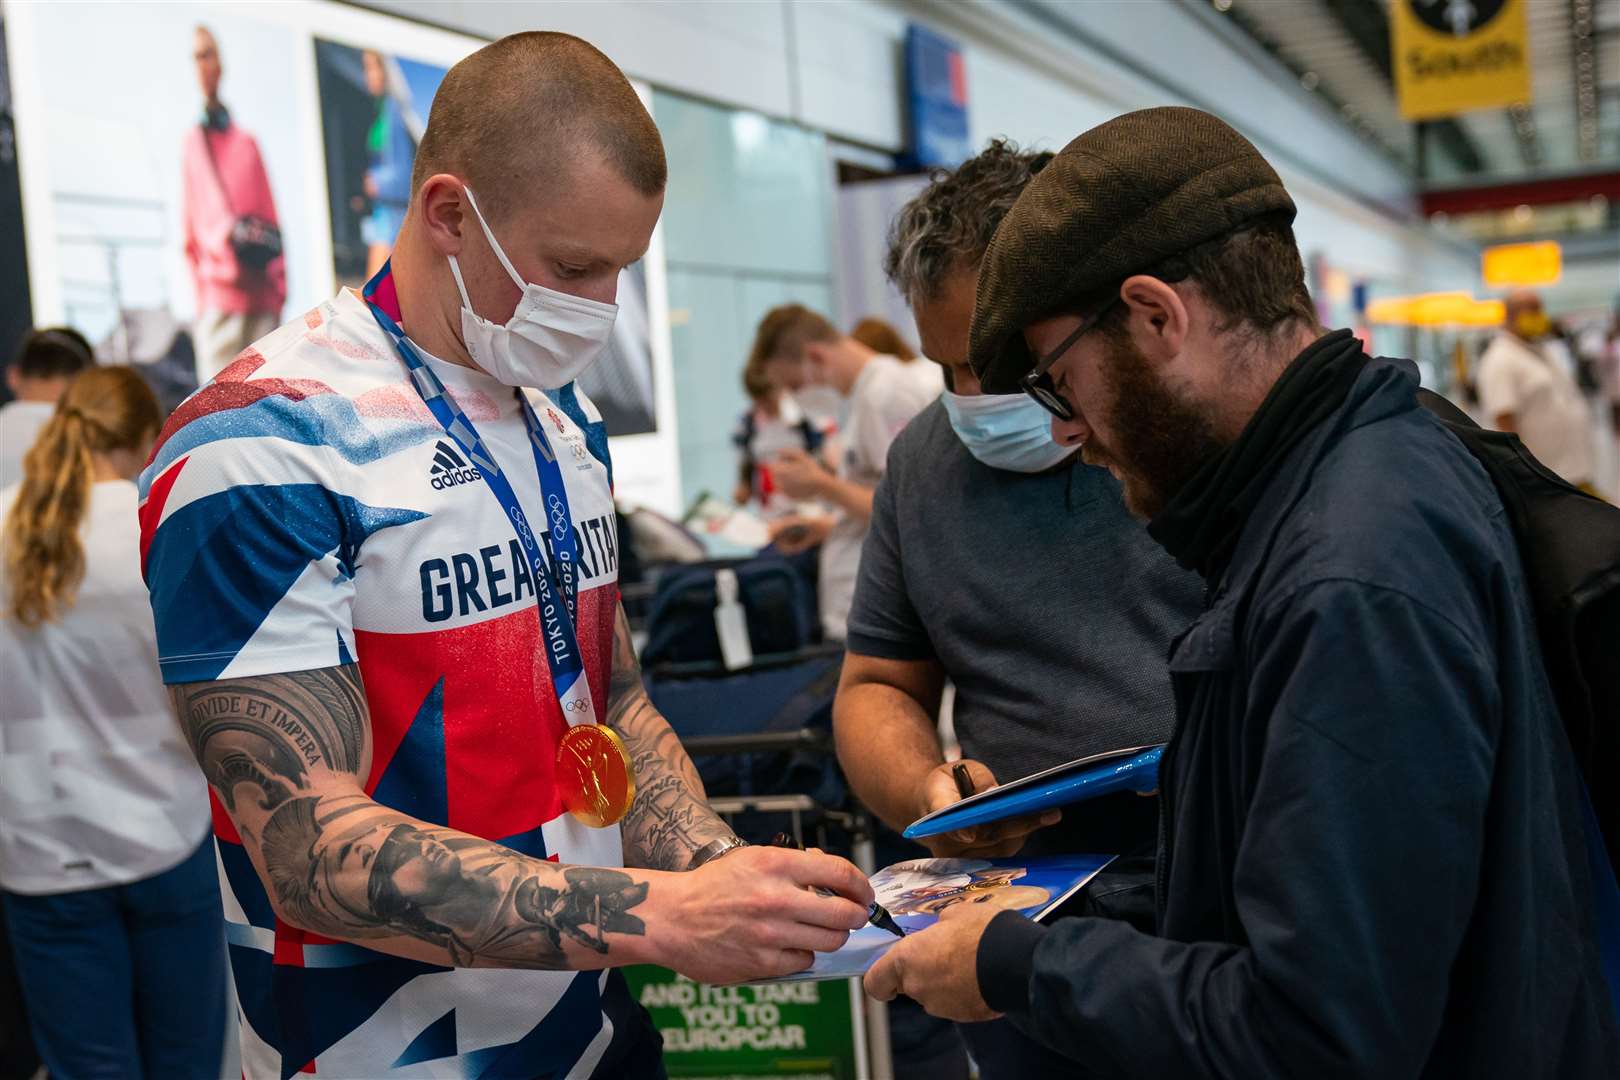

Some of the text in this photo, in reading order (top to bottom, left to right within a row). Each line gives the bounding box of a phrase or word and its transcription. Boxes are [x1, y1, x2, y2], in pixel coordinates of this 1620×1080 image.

[431, 466, 481, 490] adidas
[419, 511, 618, 622] GREA RITAI
[559, 551, 574, 595] 2020
[534, 556, 570, 665] TOKYO 2020
[191, 696, 322, 767] DIVIDE ET IMPERA
[640, 983, 695, 1008] AND
[748, 981, 820, 1005] TAKE
[679, 1003, 780, 1028] YOU TO
[660, 1026, 807, 1052] EUROPCAR
